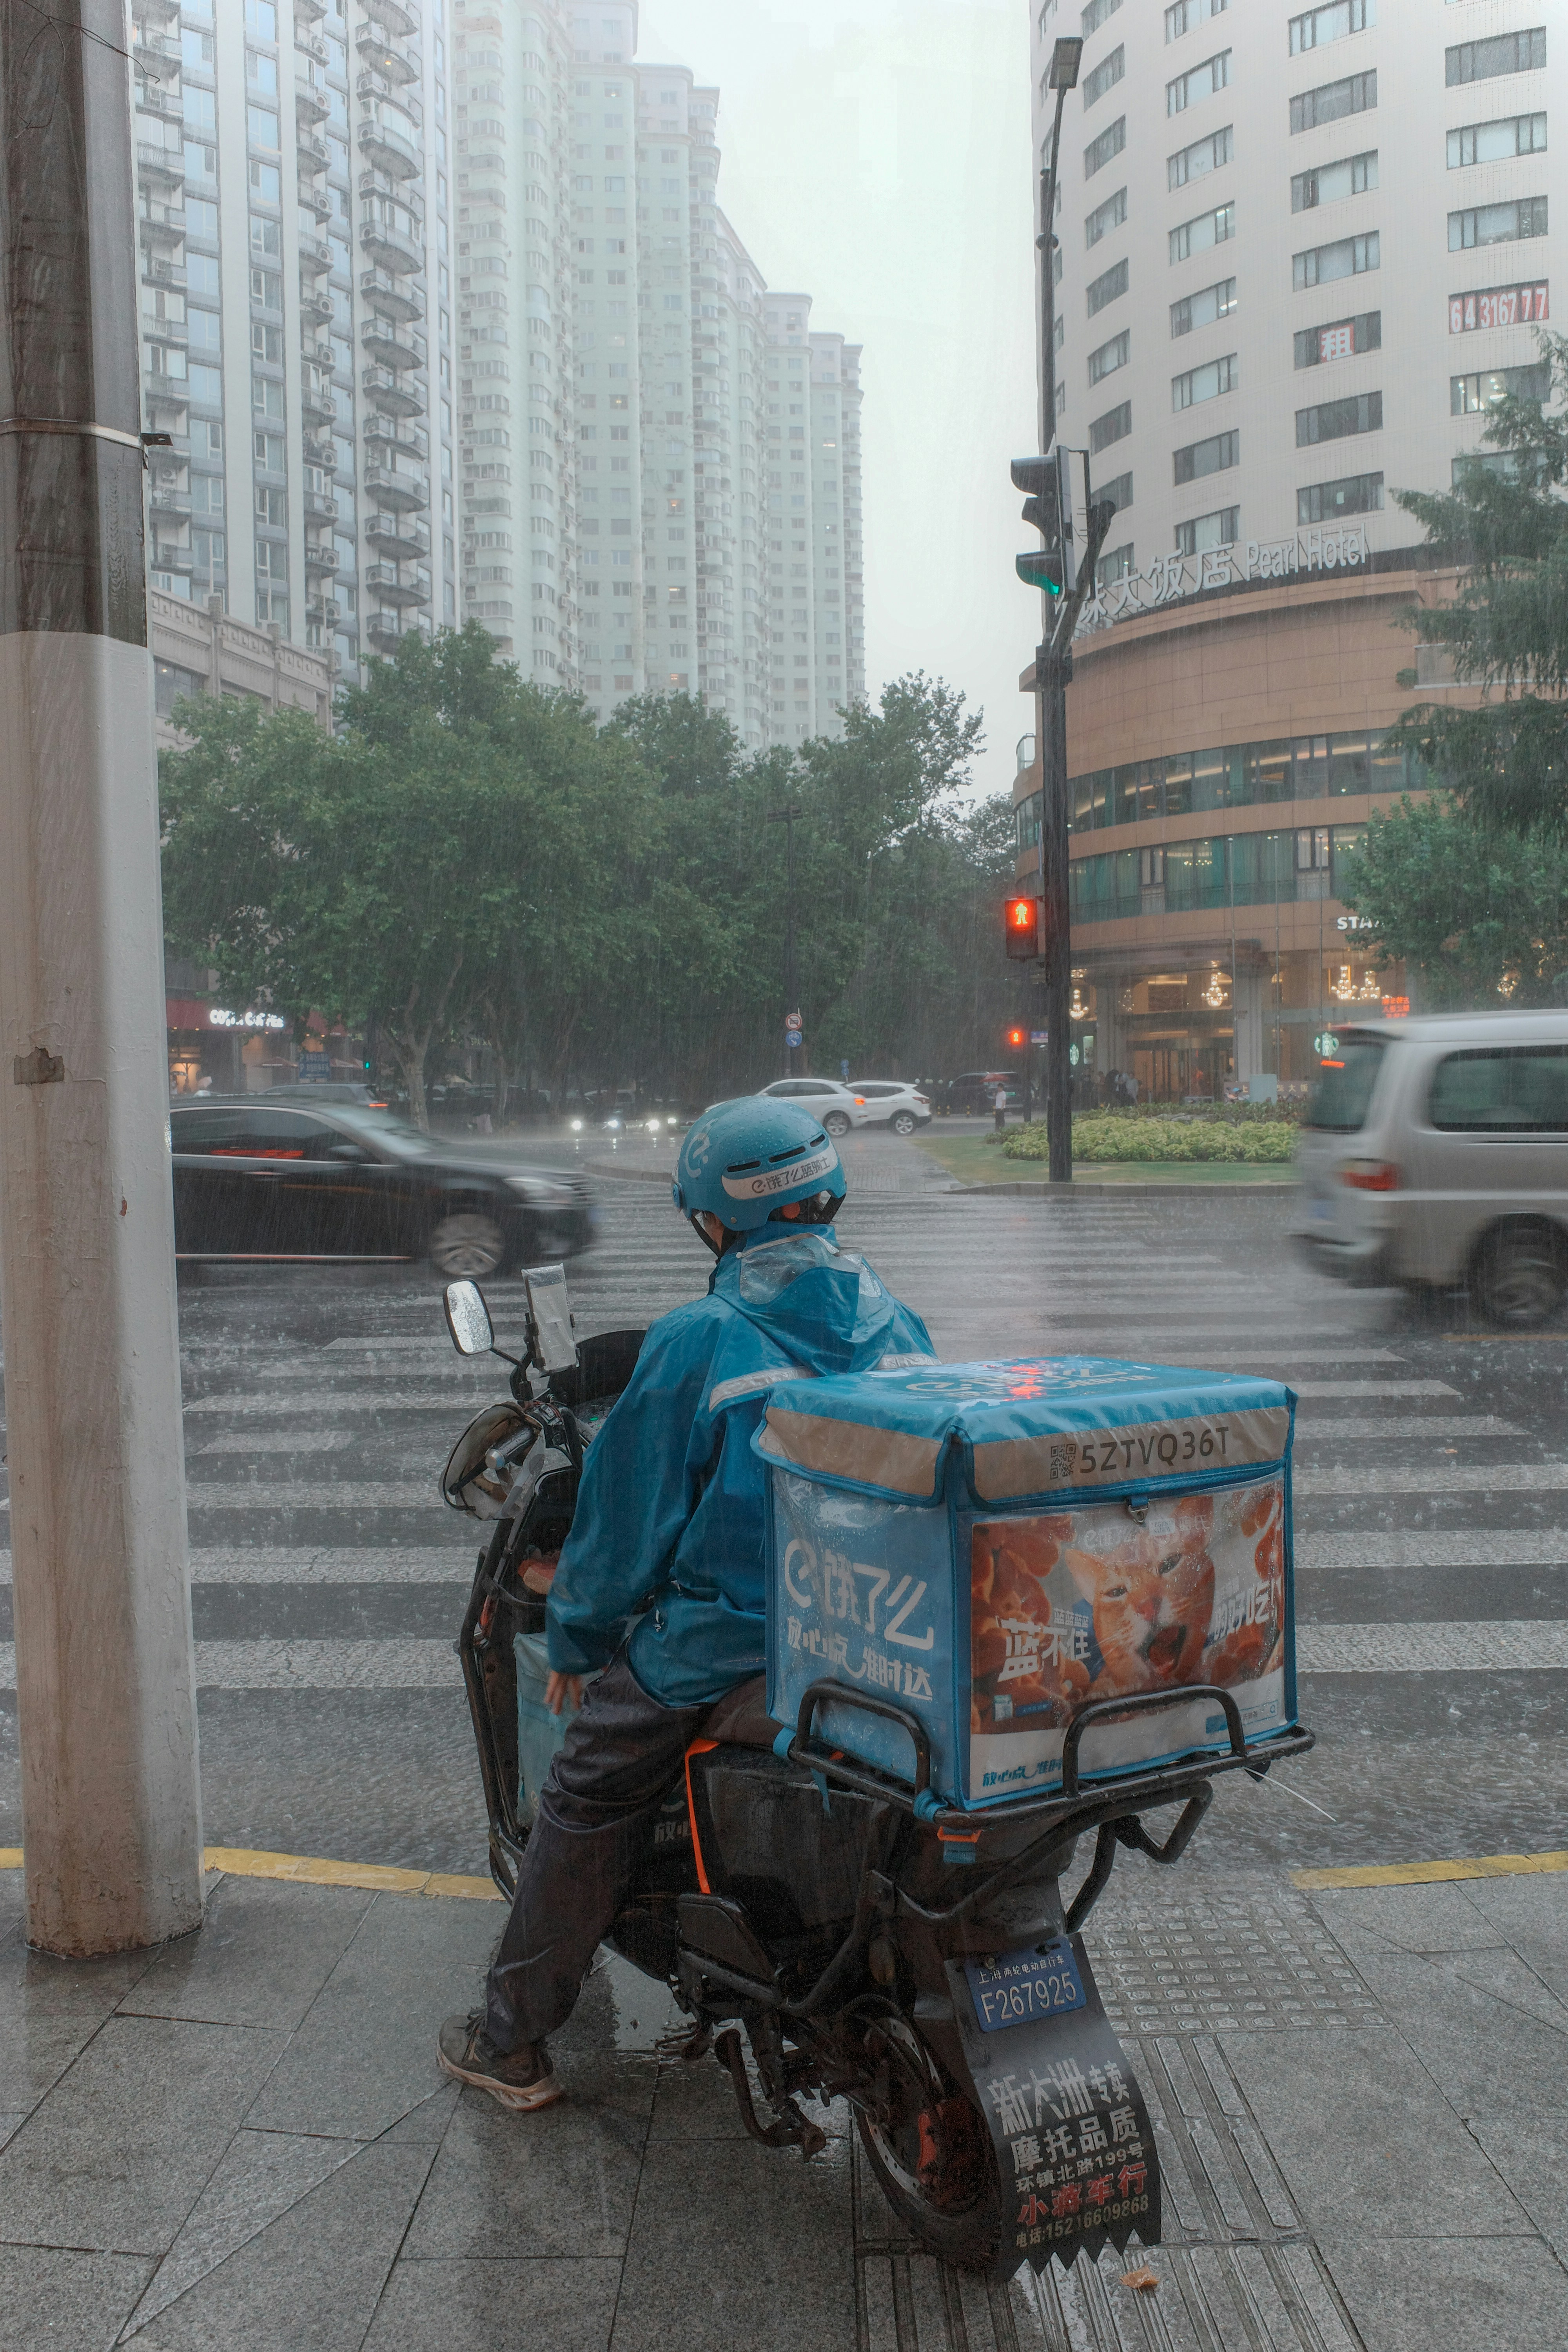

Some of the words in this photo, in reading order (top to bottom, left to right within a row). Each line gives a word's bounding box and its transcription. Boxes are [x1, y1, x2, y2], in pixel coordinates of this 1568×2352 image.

[1451, 287, 1547, 333] 64316777
[1321, 329, 1353, 360] 租
[1246, 532, 1299, 581] Pearl
[1308, 523, 1366, 571] Hotel
[1080, 1426, 1229, 1473] 5ZTVQ36T
[981, 1971, 1076, 2023] F267925
[1010, 2105, 1140, 2174] 摩托品质
[1015, 2141, 1145, 2193] 环镇北路199号
